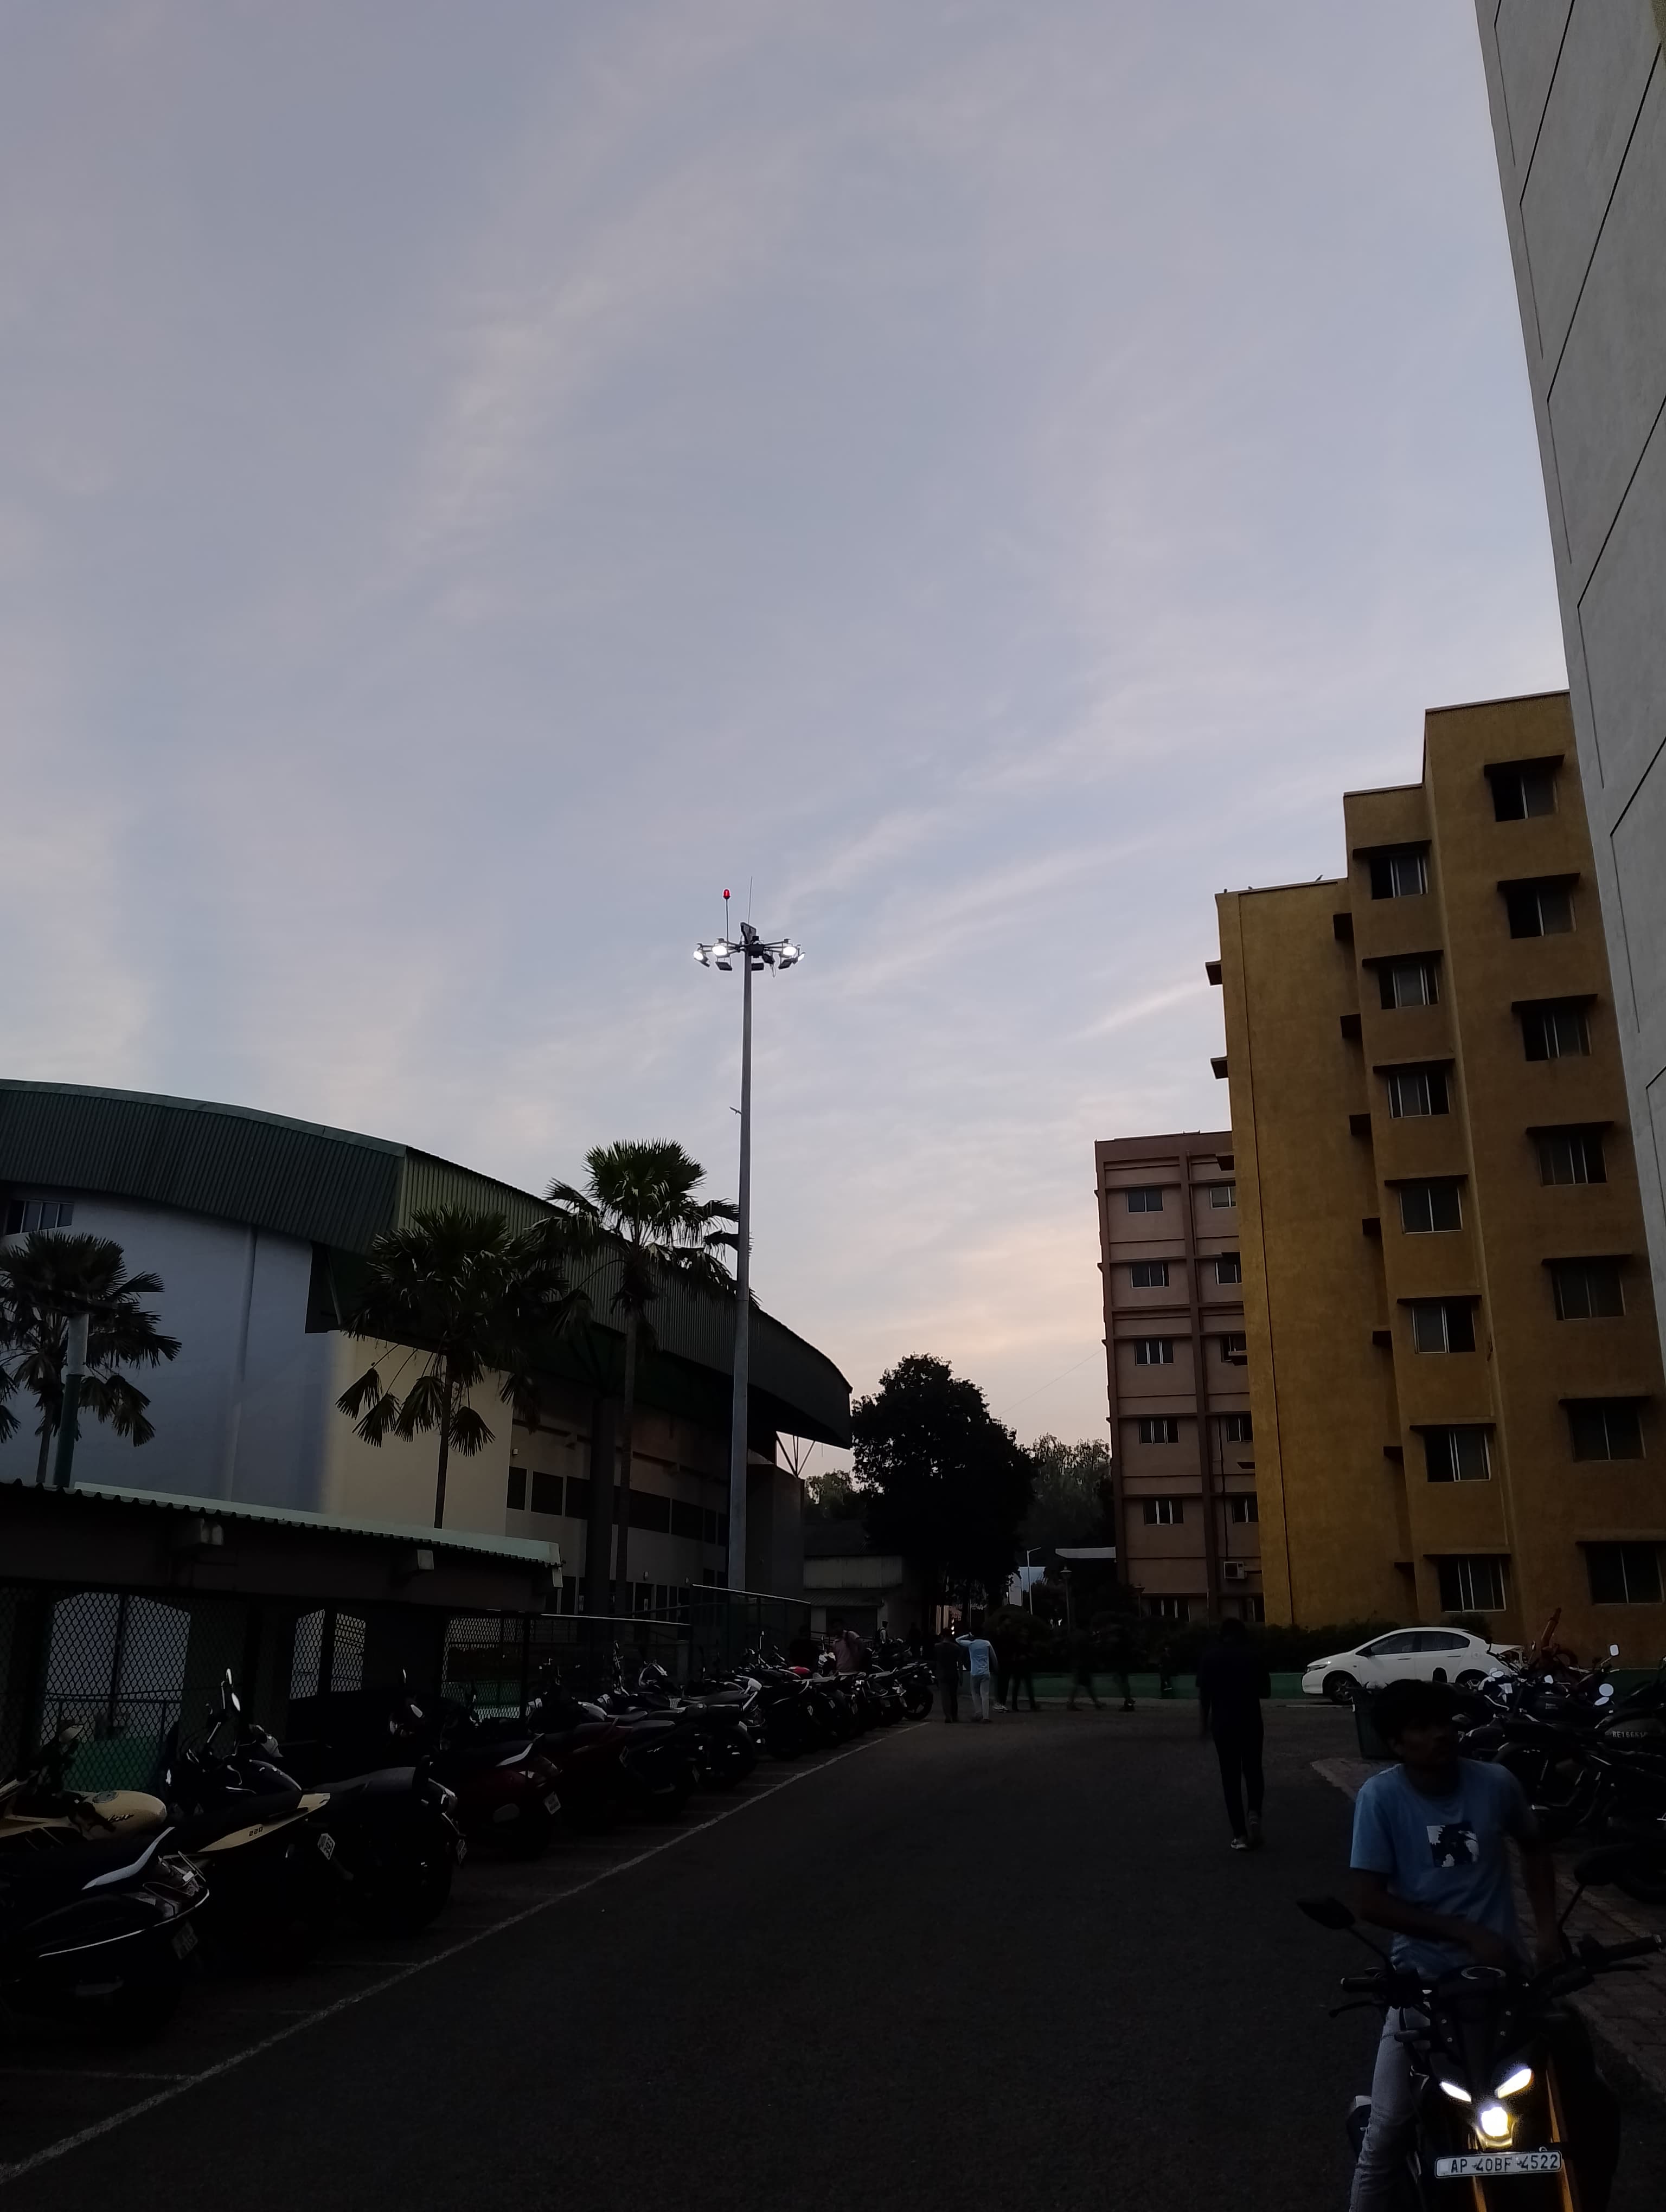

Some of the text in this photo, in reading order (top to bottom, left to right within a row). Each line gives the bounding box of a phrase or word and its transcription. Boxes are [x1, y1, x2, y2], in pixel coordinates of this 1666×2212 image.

[249, 1827, 263, 1836] 220
[1451, 2154, 1558, 2173] AP 40BF 4522
